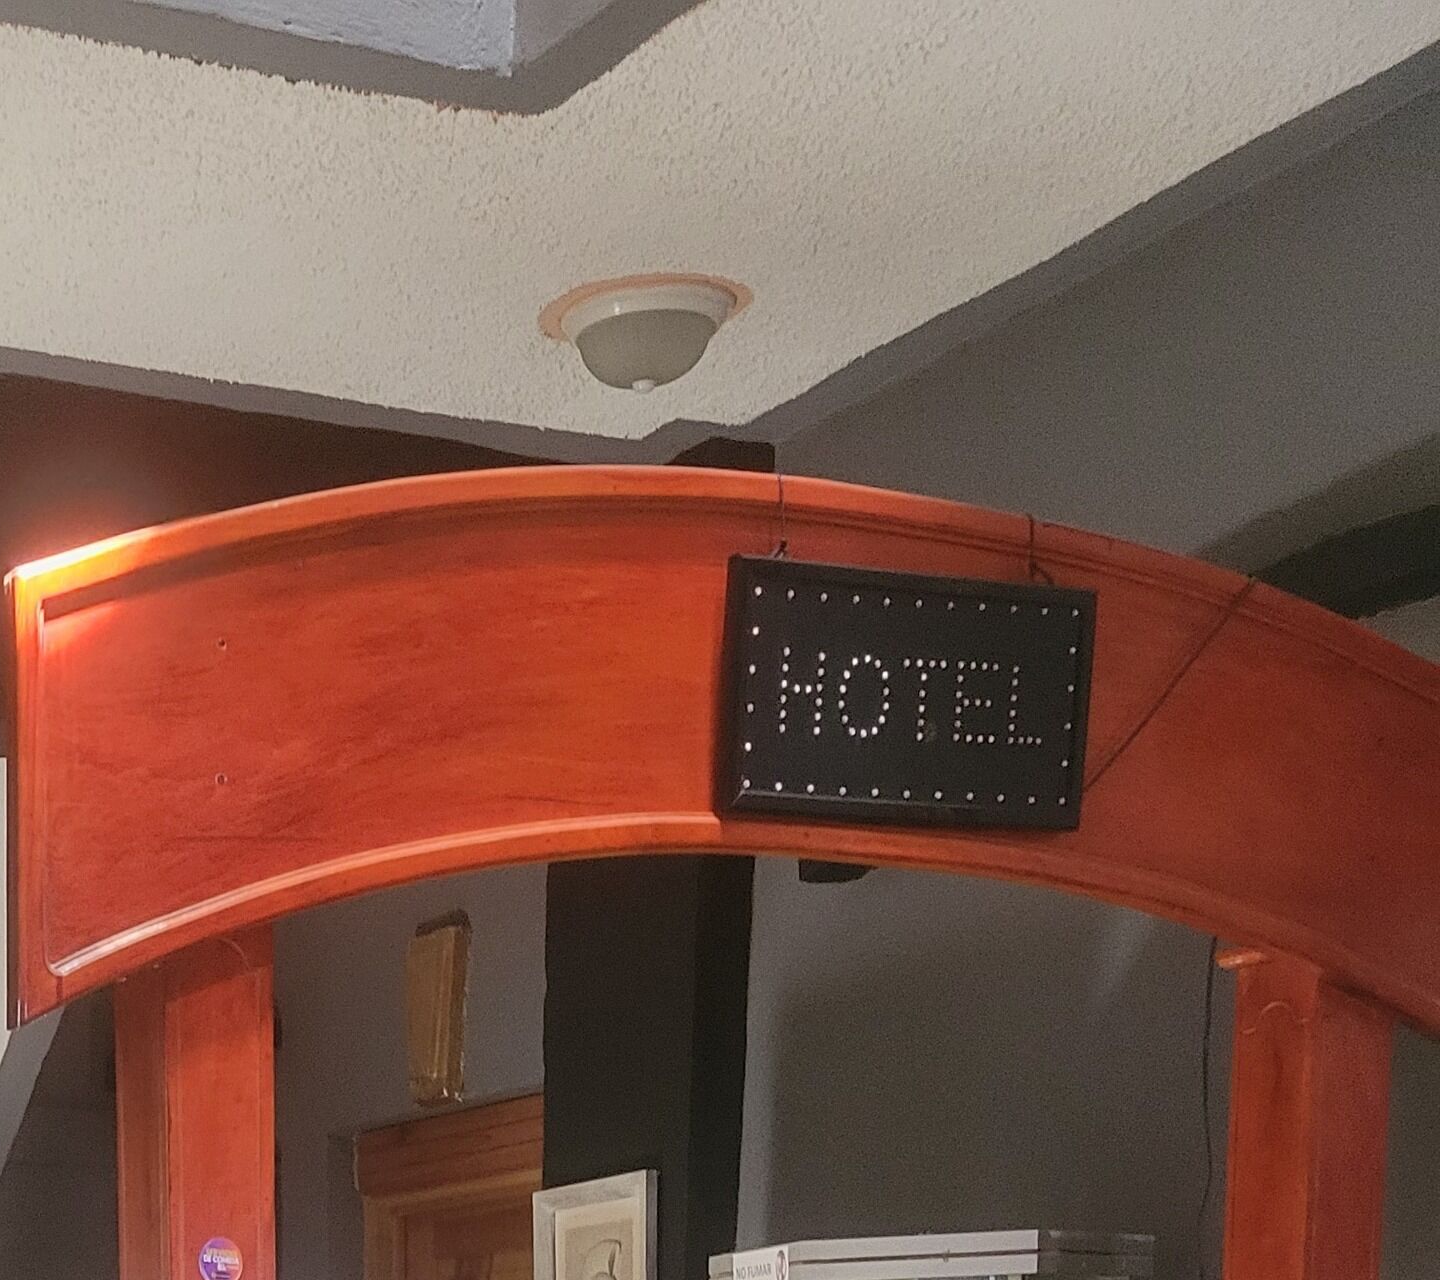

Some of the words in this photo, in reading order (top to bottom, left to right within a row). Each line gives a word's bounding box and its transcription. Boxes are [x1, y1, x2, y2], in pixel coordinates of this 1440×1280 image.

[778, 645, 1042, 745] HOTEL
[736, 1266, 746, 1280] NO
[747, 1263, 772, 1279] FUMAR
